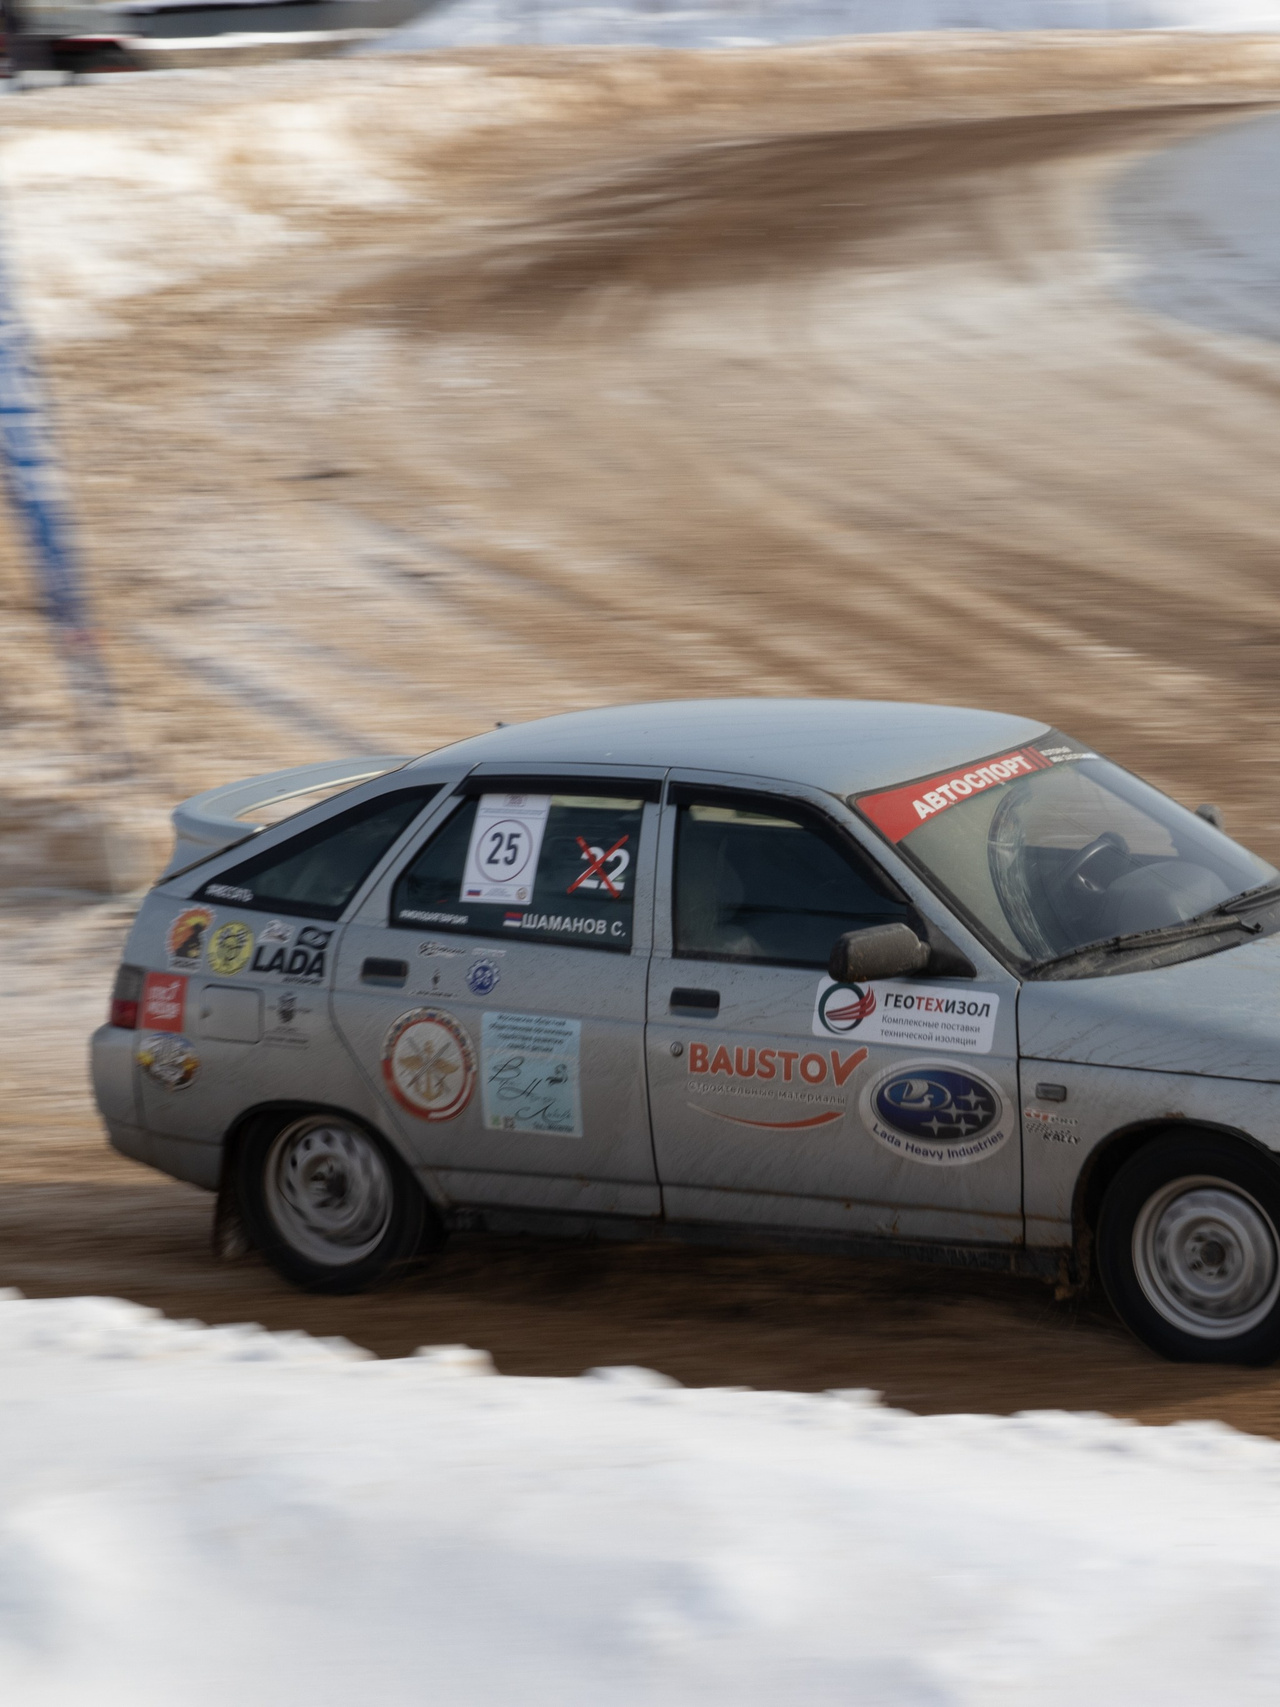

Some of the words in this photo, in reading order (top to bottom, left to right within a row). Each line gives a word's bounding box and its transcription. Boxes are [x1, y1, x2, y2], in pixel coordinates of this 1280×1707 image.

[912, 755, 1033, 819] АВТОСПОРТ
[486, 831, 521, 865] 25
[577, 846, 630, 891] 22
[521, 913, 606, 934] ШАМАНОВ
[611, 921, 626, 937] С.
[250, 945, 326, 977] LADA
[884, 993, 991, 1017] ГЕОТЕХИЗОЛ
[880, 1028, 933, 1041] технической
[935, 1035, 976, 1047] изоляции
[881, 1015, 939, 1029] Комплексные
[941, 1022, 981, 1033] поставки
[688, 1042, 868, 1087] BAUSTOV
[778, 1091, 845, 1105] материалы
[872, 1123, 901, 1147] Lada
[905, 1141, 943, 1160] Heavy
[947, 1131, 1004, 1158] Industries
